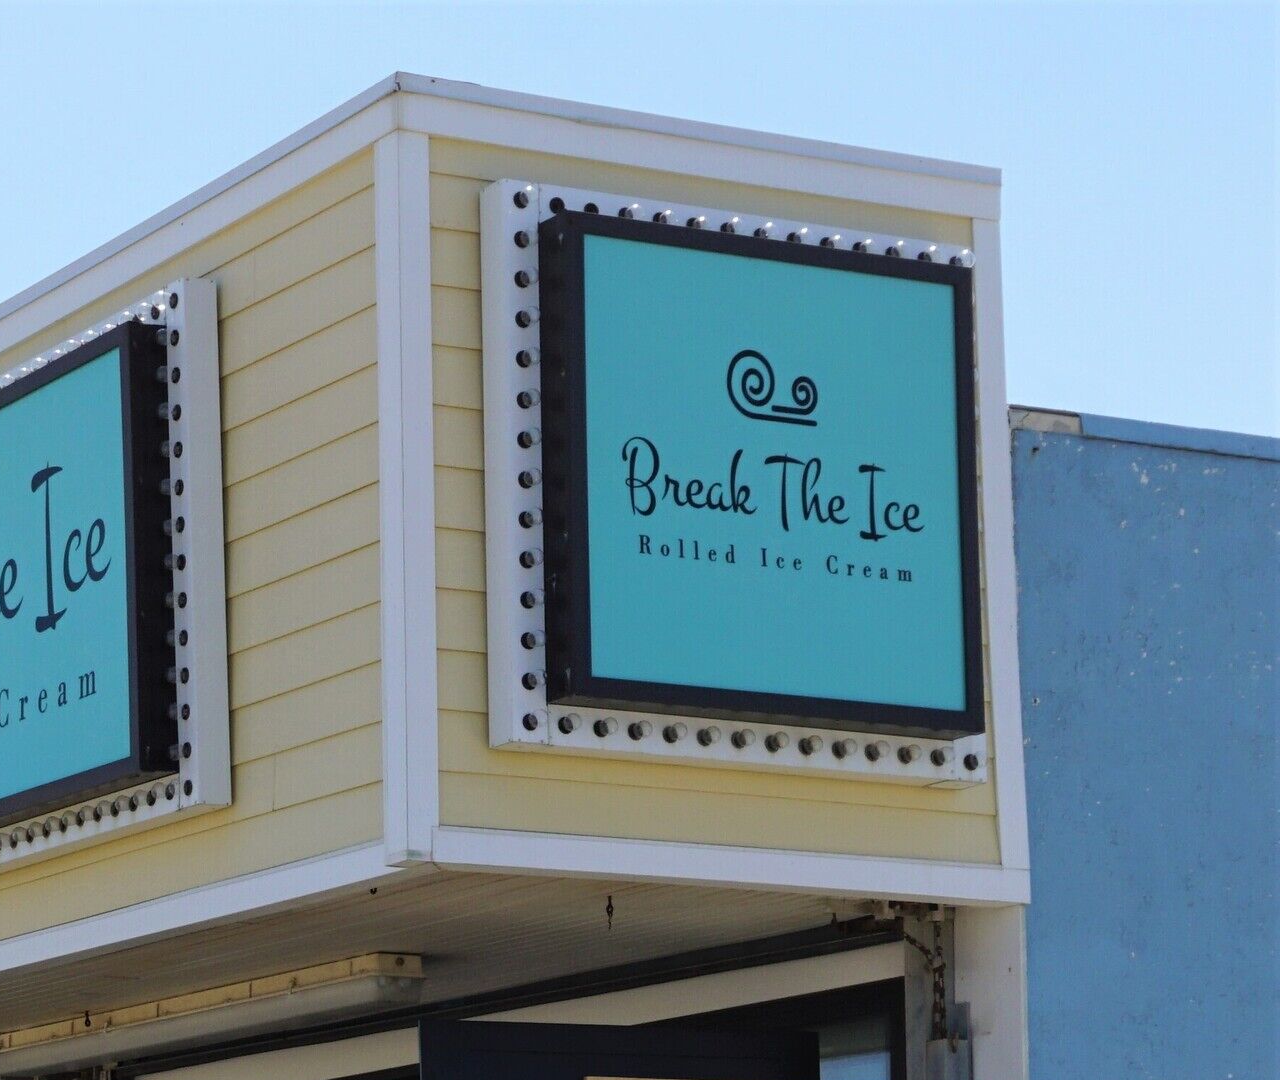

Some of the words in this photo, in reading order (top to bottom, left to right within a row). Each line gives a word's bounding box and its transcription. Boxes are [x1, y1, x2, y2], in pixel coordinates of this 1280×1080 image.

[622, 436, 758, 516] Break
[765, 454, 850, 531] The
[859, 463, 925, 541] Ice
[31, 462, 111, 633] Ice
[639, 534, 737, 565] Rolled
[760, 548, 802, 571] Ice
[827, 555, 913, 582] Cream
